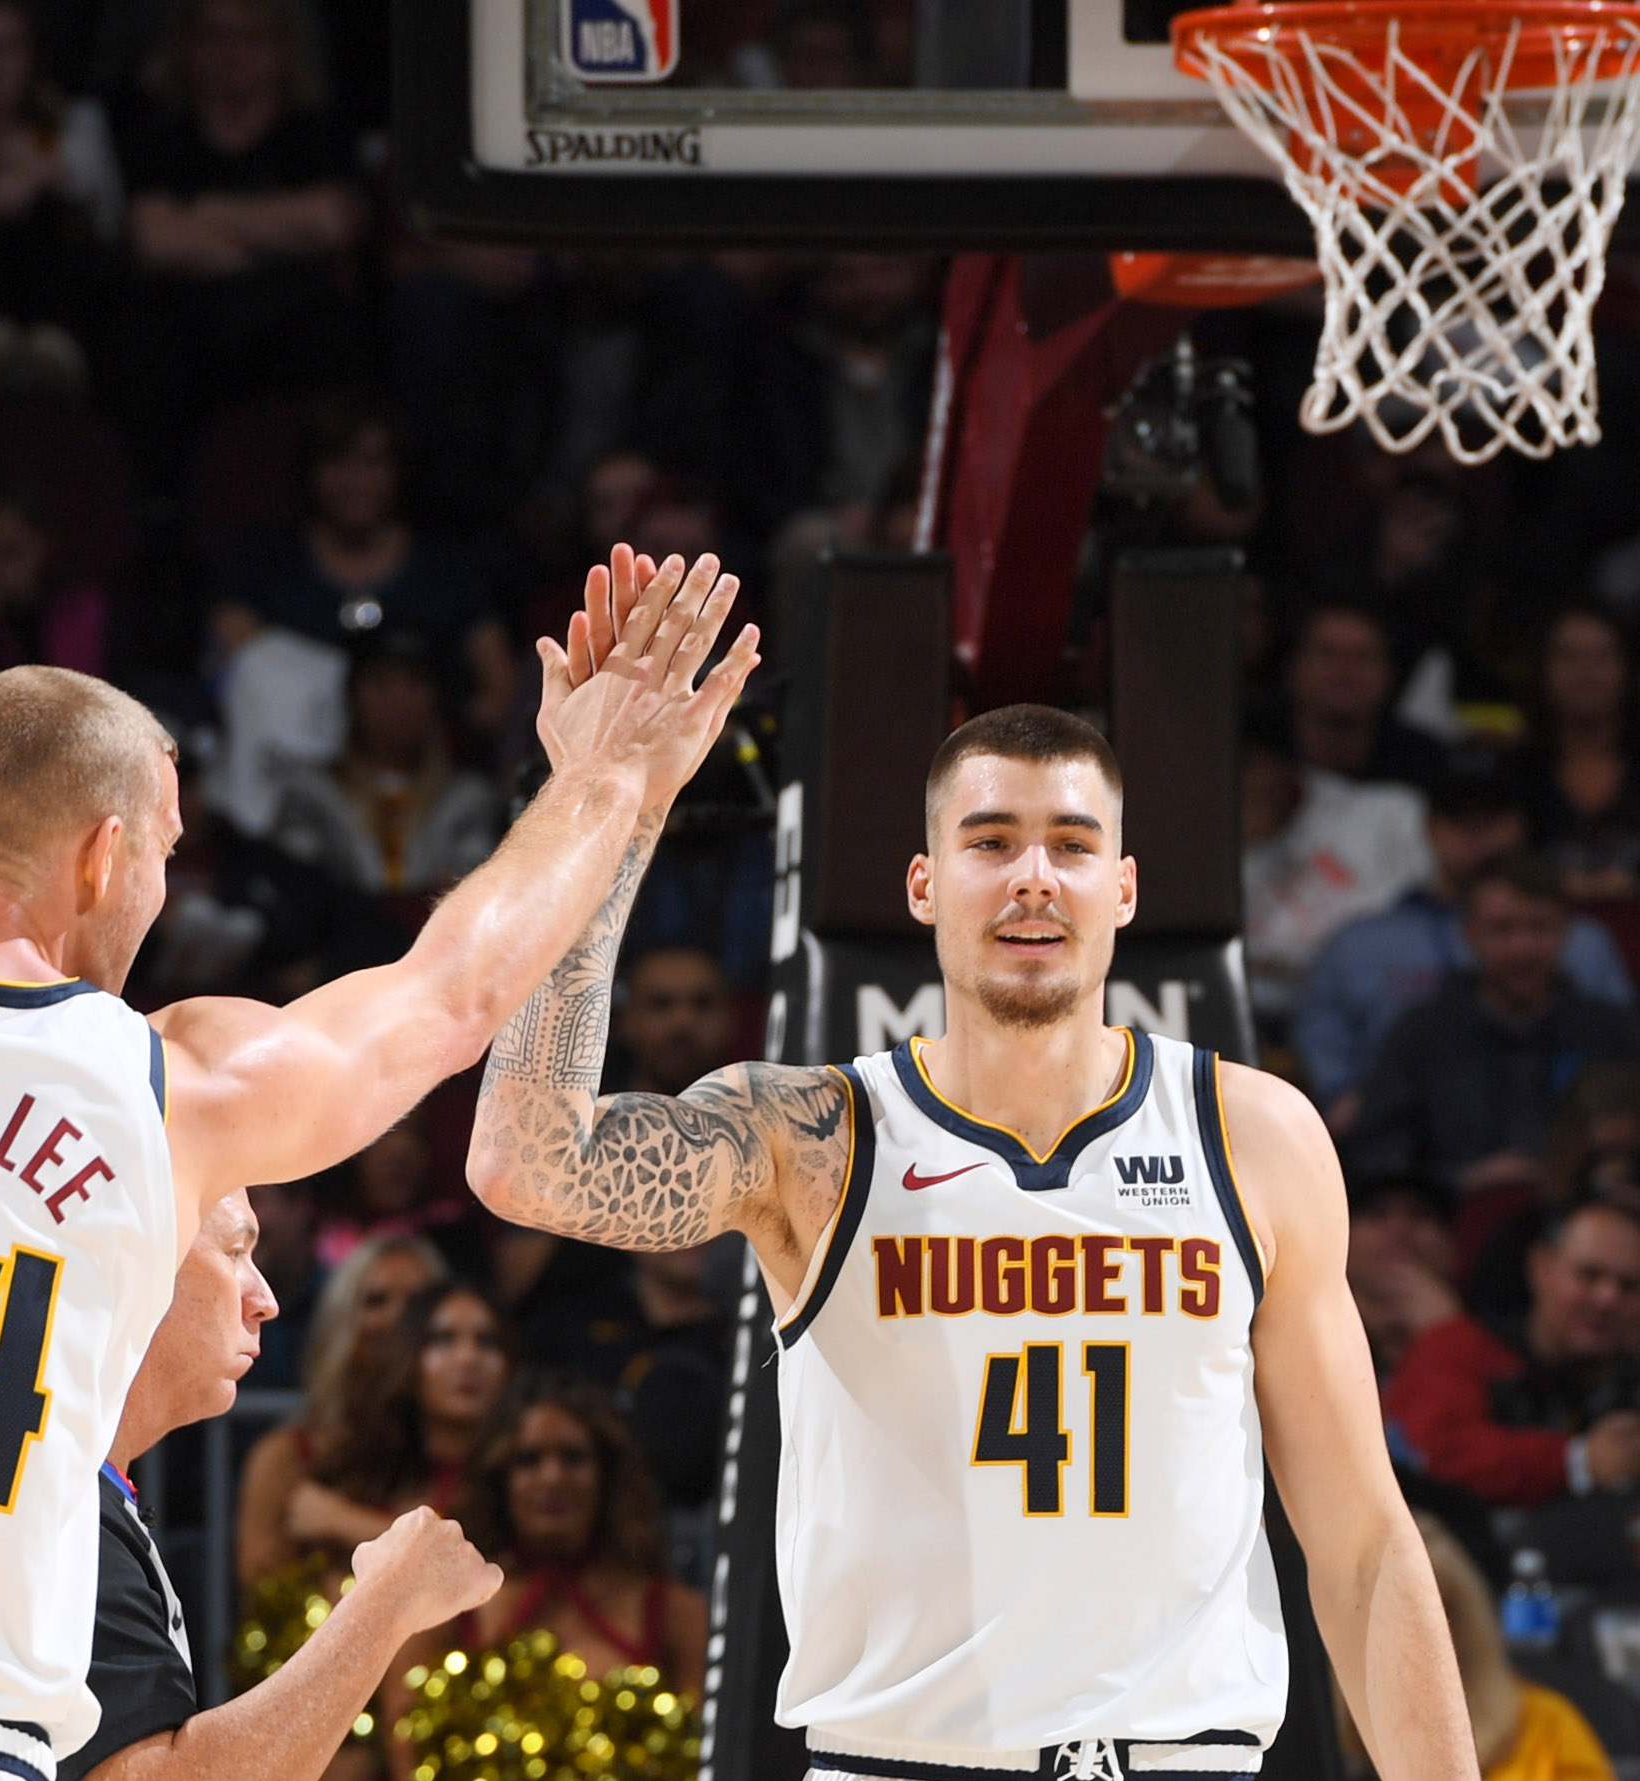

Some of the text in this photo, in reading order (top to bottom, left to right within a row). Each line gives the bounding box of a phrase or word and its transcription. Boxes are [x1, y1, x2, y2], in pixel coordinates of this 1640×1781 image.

[578, 22, 636, 62] NBA
[525, 129, 702, 166] SPALDING
[1113, 1155, 1185, 1184] WU
[1118, 1187, 1188, 1197] WESTERN
[1142, 1196, 1190, 1207] UNION
[871, 1233, 1223, 1321] NUGGETS
[970, 1340, 1132, 1518] 41
